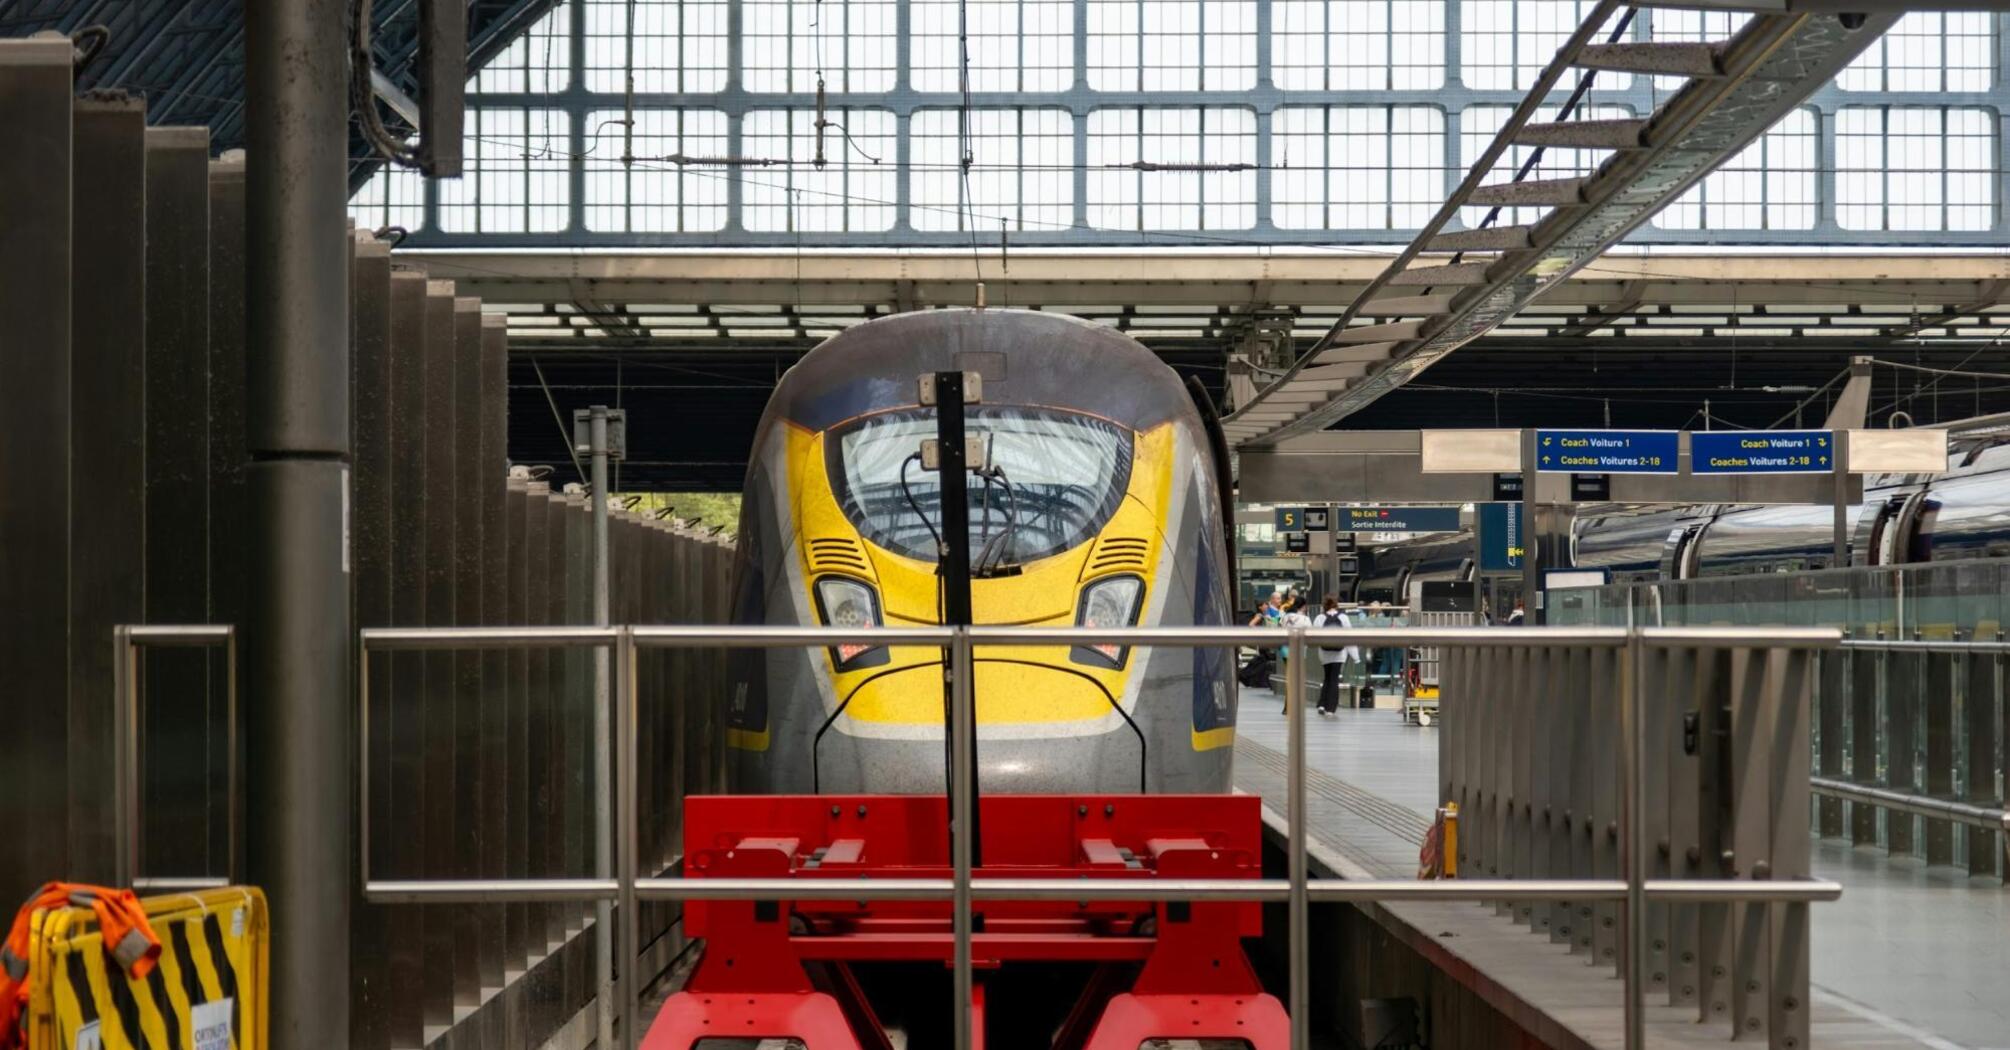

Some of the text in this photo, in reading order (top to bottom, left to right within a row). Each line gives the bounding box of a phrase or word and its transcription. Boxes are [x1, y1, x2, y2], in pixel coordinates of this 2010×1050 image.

[1560, 438, 1631, 448] Coach Voiture 1
[1740, 438, 1810, 448] Coach Voiture 1
[1560, 455, 1661, 466] Coaches Voitures 2-18
[1710, 456, 1810, 466] Coaches Voitures 2-18
[1351, 510, 1378, 518] No Exit
[1285, 514, 1294, 527] 5
[1351, 519, 1407, 529] Sortie Interdite
